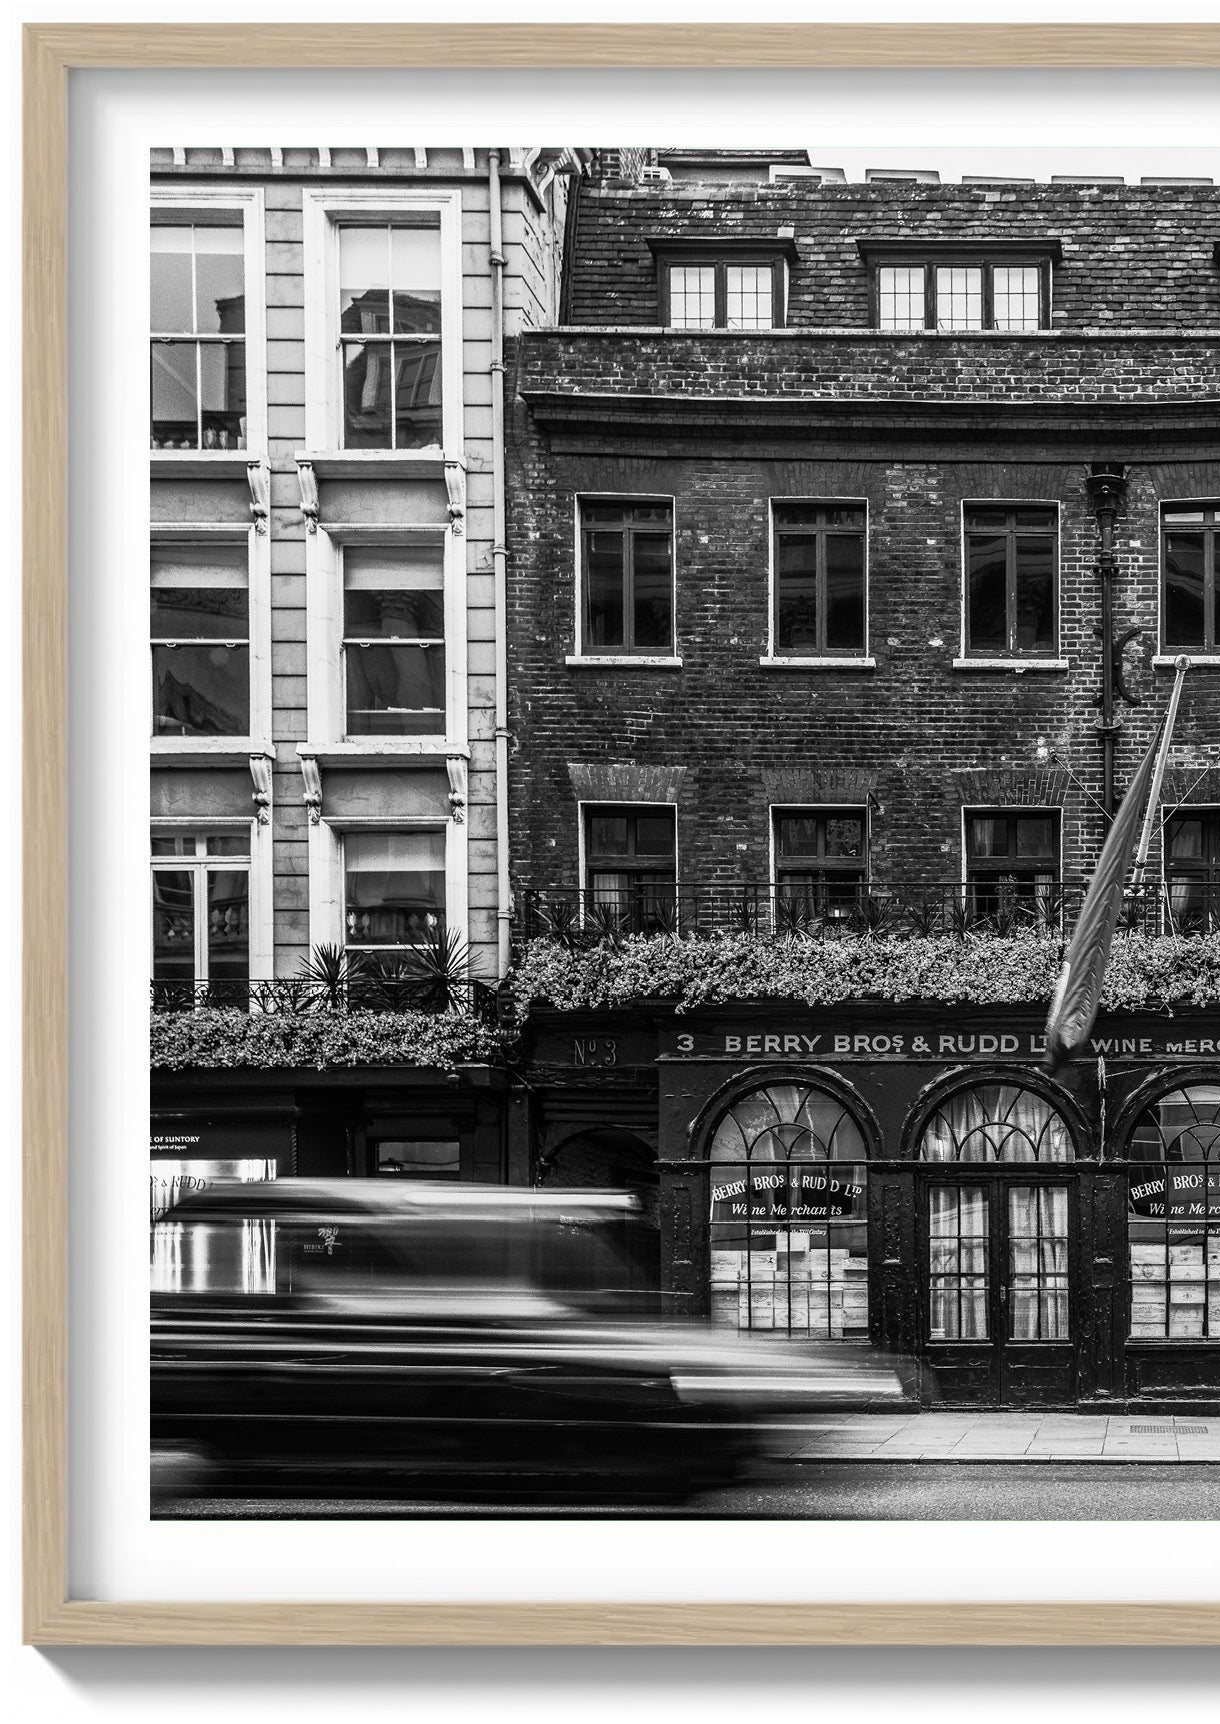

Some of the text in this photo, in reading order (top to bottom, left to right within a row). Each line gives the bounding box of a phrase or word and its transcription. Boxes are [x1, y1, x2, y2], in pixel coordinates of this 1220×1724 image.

[605, 1039, 616, 1067] 3
[677, 1034, 694, 1052] 3
[725, 1035, 822, 1052] BERRY
[911, 1035, 932, 1052] &
[939, 1035, 1019, 1052] RUDD
[1030, 1035, 1048, 1052] LT
[1091, 1038, 1153, 1053] WINE
[172, 1175, 206, 1191] RUDD
[712, 1179, 747, 1202] BERRY
[791, 1178, 799, 1188] &
[802, 1175, 840, 1192] RUDD
[844, 1183, 862, 1198] LTD
[1130, 1179, 1165, 1201] BERRY
[1207, 1177, 1215, 1187] &
[732, 1203, 842, 1216] Wine Merchants
[1150, 1203, 1185, 1215] Wine
